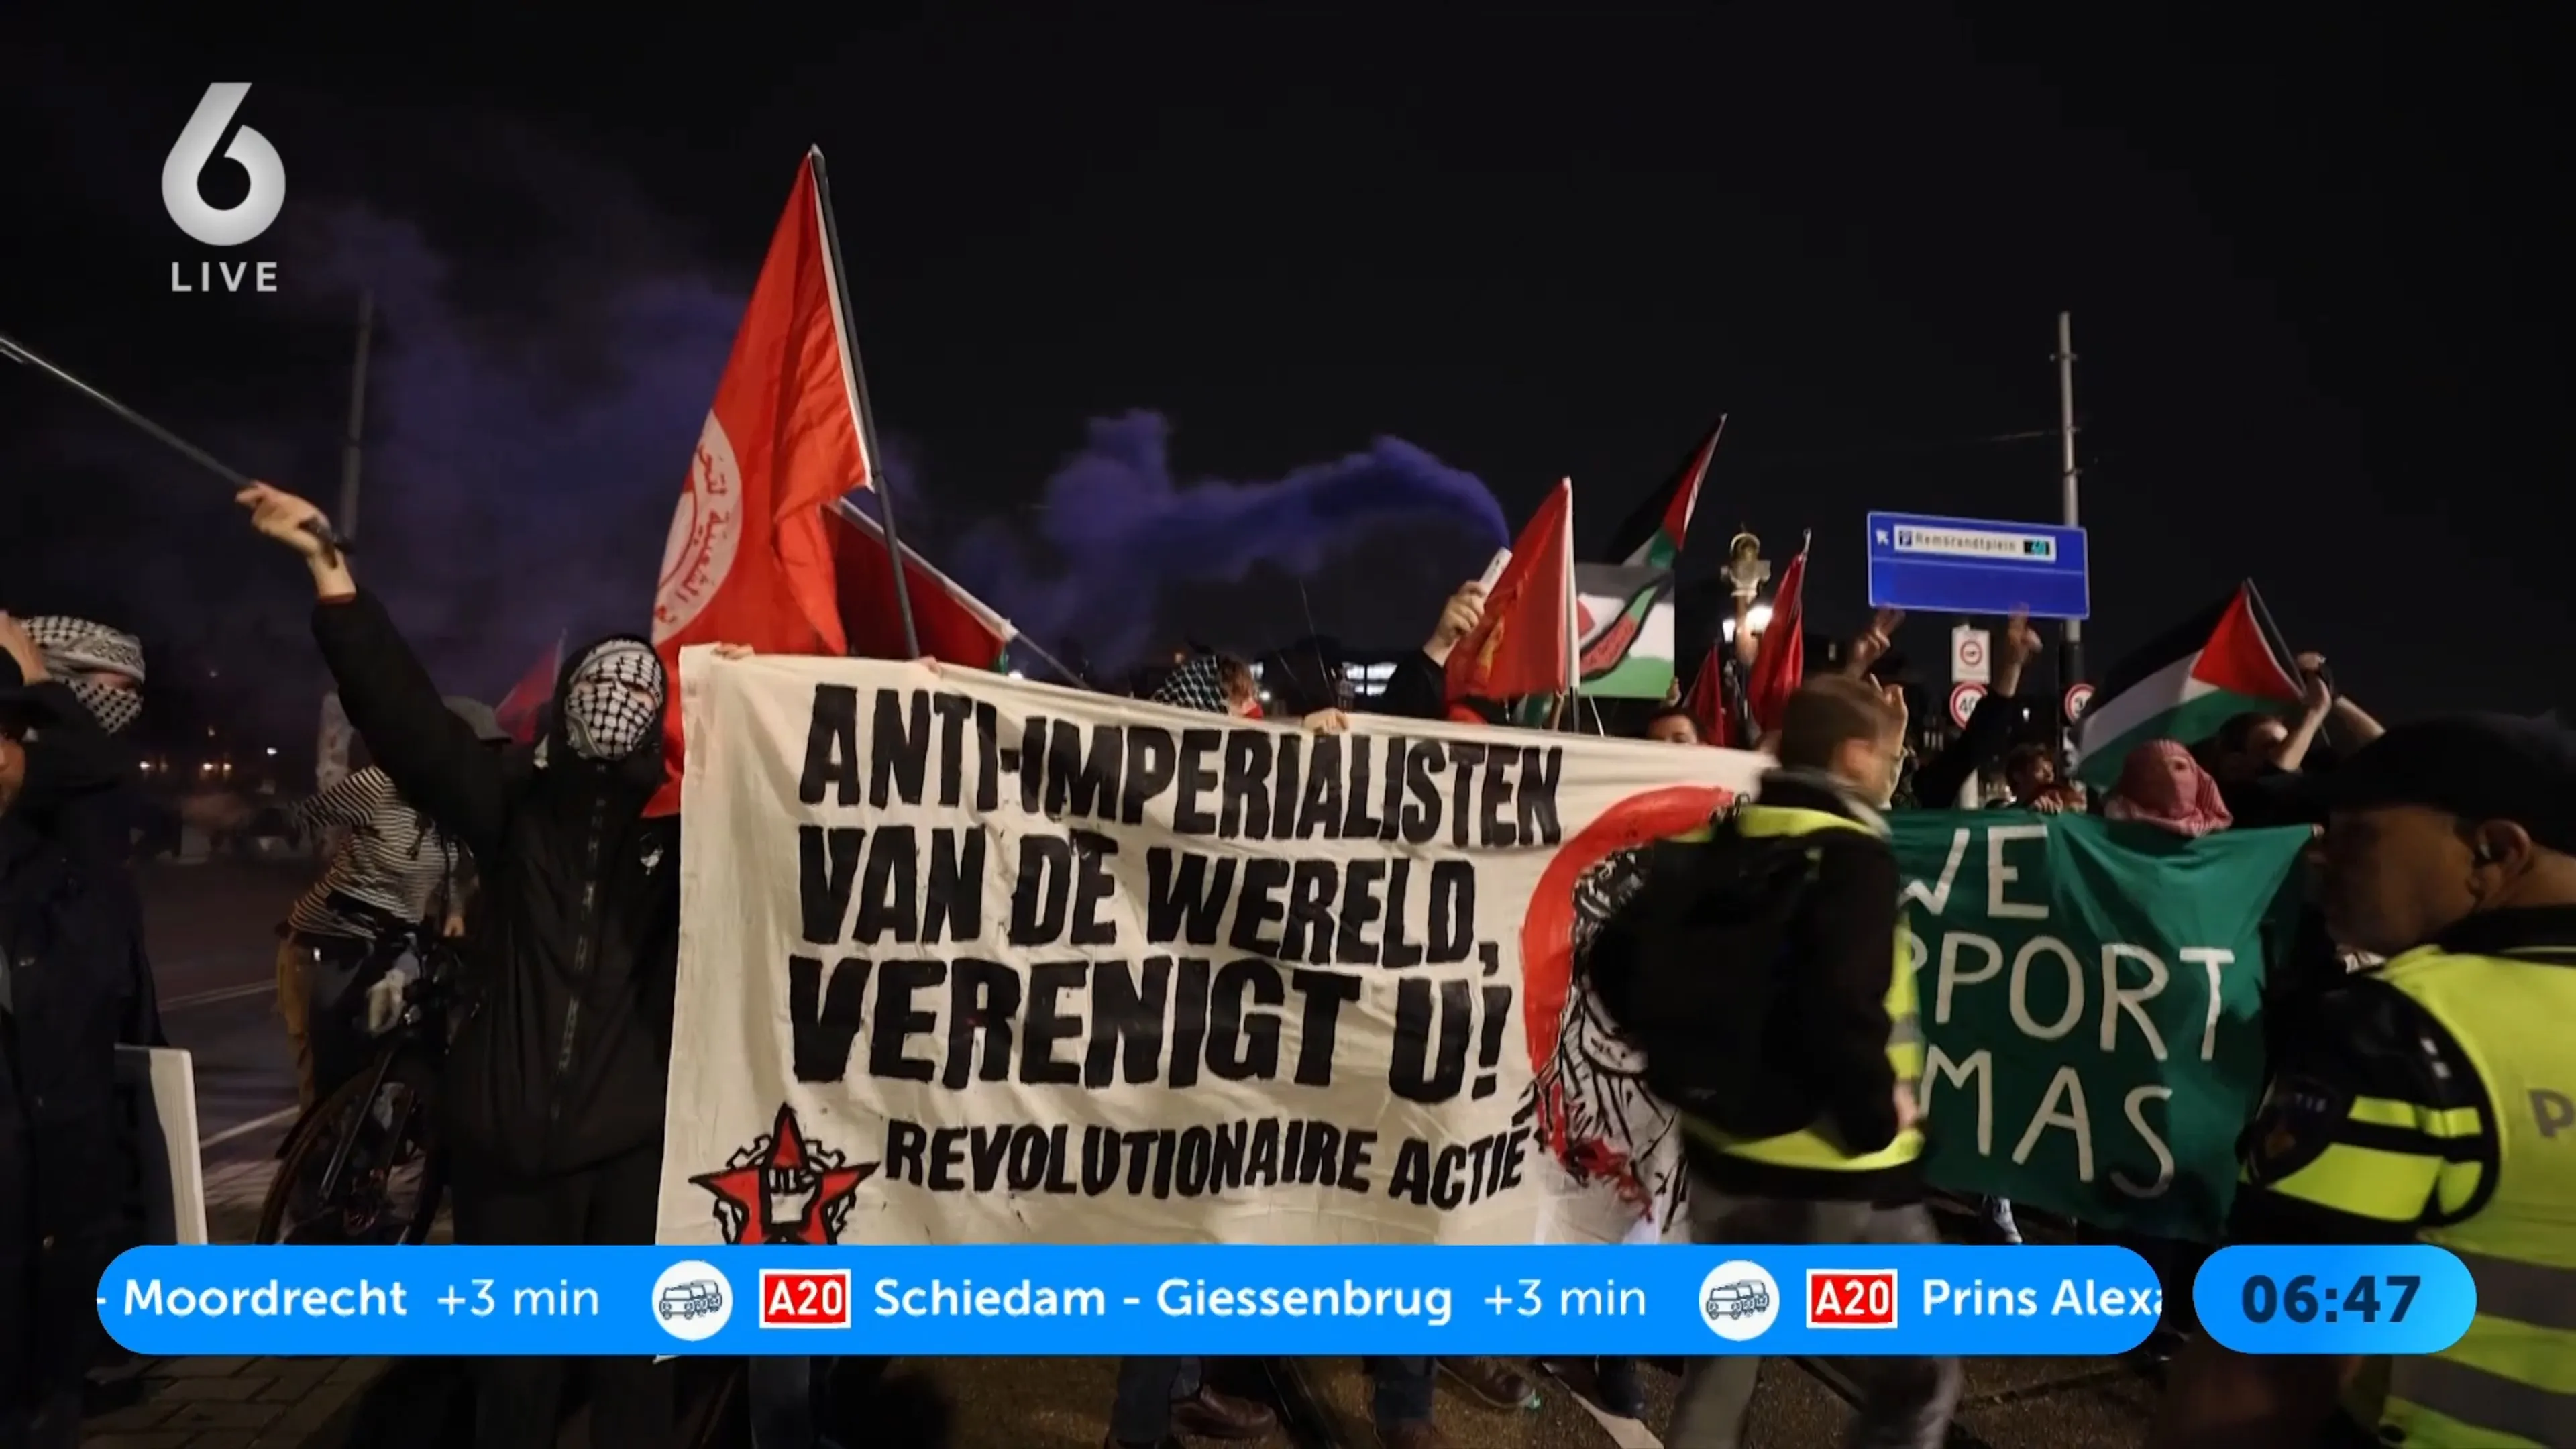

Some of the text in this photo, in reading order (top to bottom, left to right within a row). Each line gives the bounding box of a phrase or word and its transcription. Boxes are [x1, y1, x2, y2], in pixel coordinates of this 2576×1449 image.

[799, 684, 1562, 848] ANTI-IMPERIALISTEN
[799, 825, 1499, 976] VAN DE WERELD,
[789, 955, 1511, 1104] VERENIGT U!
[885, 1118, 1532, 1211] REVOLUTIONAIRE ACTIE
